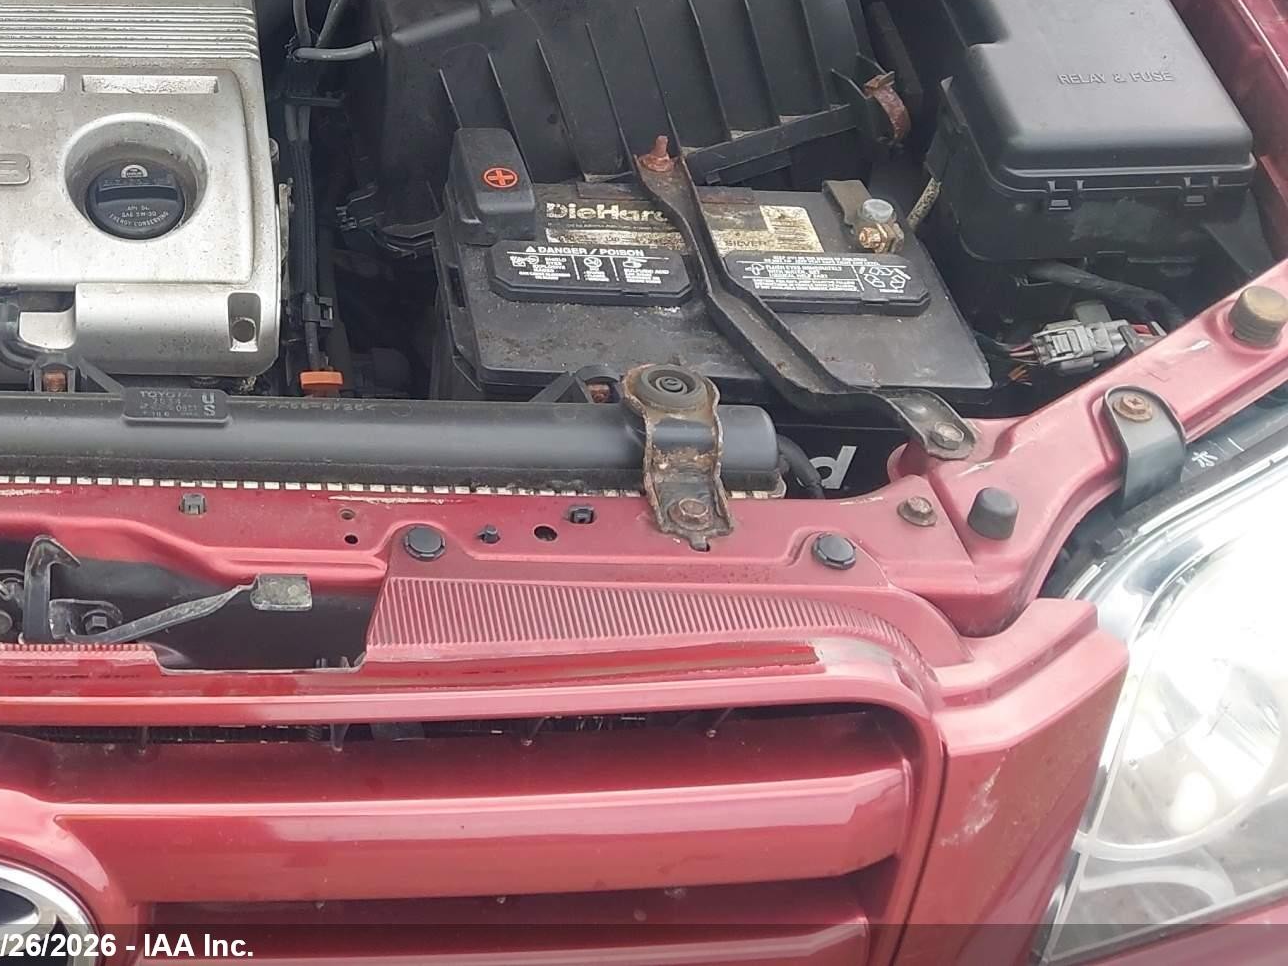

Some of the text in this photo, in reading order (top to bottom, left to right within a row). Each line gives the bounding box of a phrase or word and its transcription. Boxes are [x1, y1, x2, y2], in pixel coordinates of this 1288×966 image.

[1056, 71, 1175, 85] RELAY & FUSE
[537, 246, 588, 256] DANGER
[599, 248, 645, 258] POISON
[139, 390, 193, 398] TOYOTA
